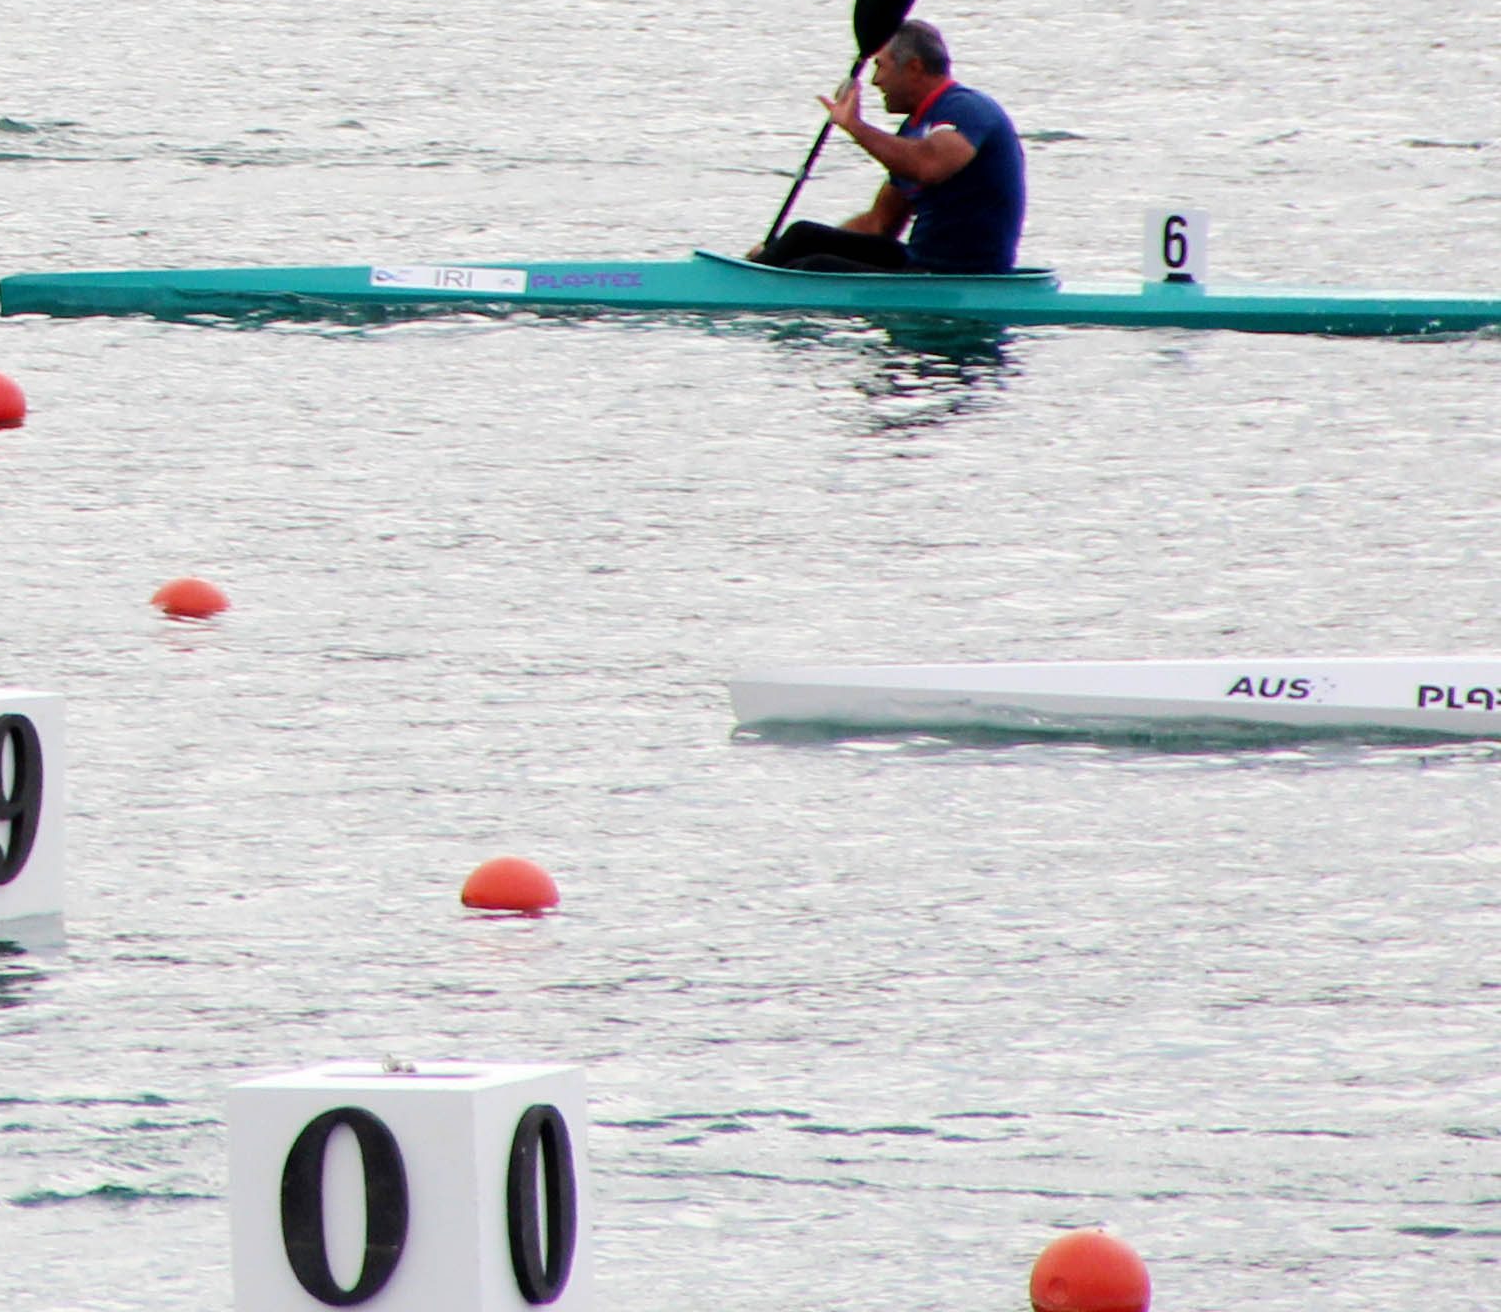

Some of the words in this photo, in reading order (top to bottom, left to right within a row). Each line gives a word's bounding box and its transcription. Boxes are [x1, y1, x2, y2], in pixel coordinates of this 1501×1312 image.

[1164, 215, 1187, 268] 6
[432, 269, 474, 288] IRI
[1227, 676, 1311, 699] AUS
[1416, 685, 1501, 710] PLA
[281, 1106, 409, 1306] 0
[507, 1104, 577, 1305] 0
